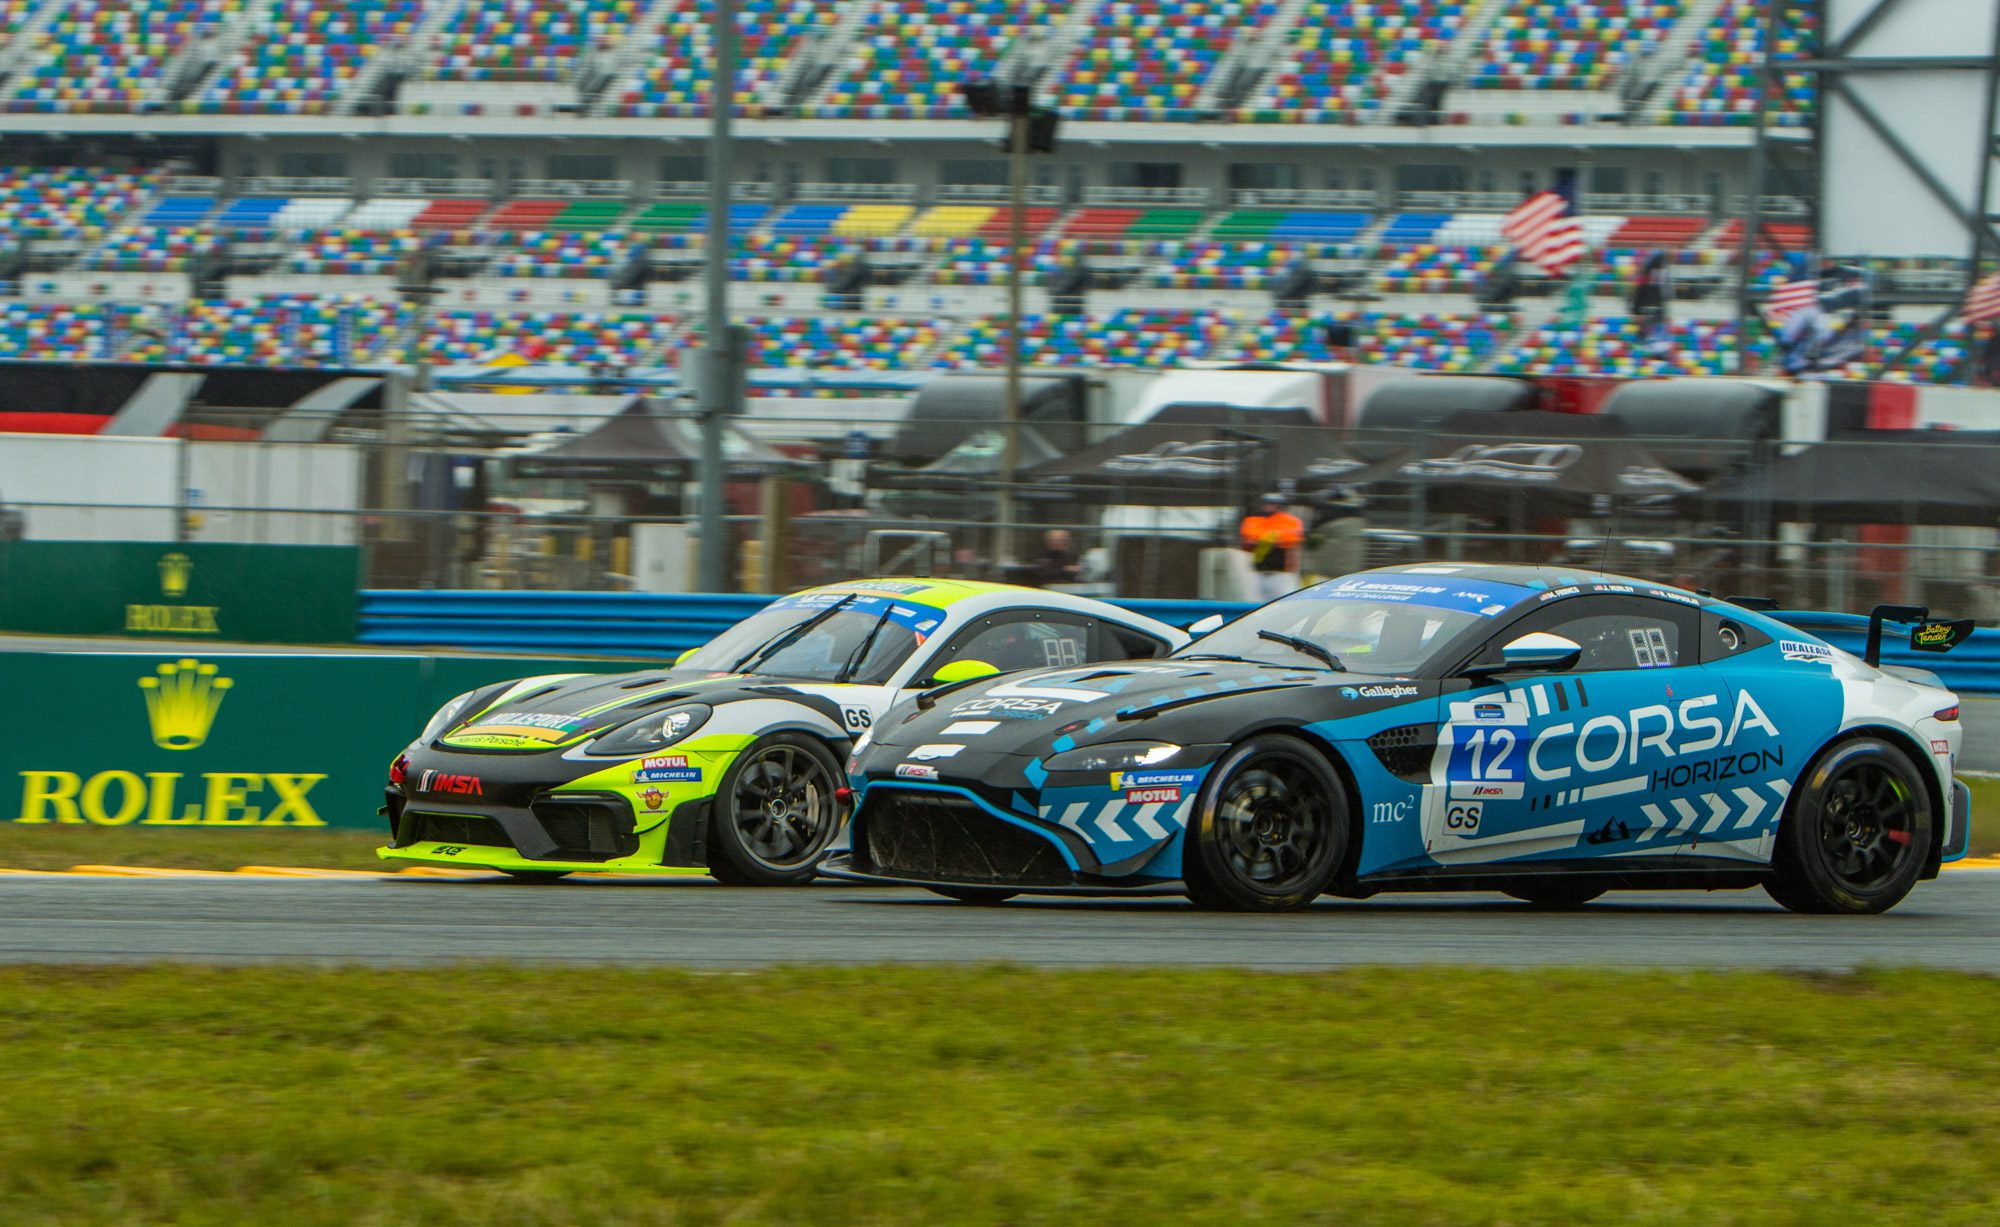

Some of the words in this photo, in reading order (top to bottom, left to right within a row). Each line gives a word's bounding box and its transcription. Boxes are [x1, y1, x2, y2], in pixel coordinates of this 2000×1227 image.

[1918, 631, 1948, 645] Tender
[1925, 624, 1952, 635] Battery
[1781, 642, 1834, 657] IDEALEASE
[1359, 685, 1419, 699] Gallagher
[951, 698, 1063, 715] CORSA
[845, 708, 873, 729] GS
[1528, 688, 1780, 781] CORSA
[644, 756, 687, 768] MOTUL
[1464, 728, 1516, 779] 12
[1652, 745, 1784, 792] HORIZON
[433, 773, 483, 796] IMSA
[1137, 774, 1194, 784] MICHELIN
[13, 769, 329, 826] ROLEX
[1129, 789, 1179, 803] MOTUL
[1447, 807, 1480, 829] GS
